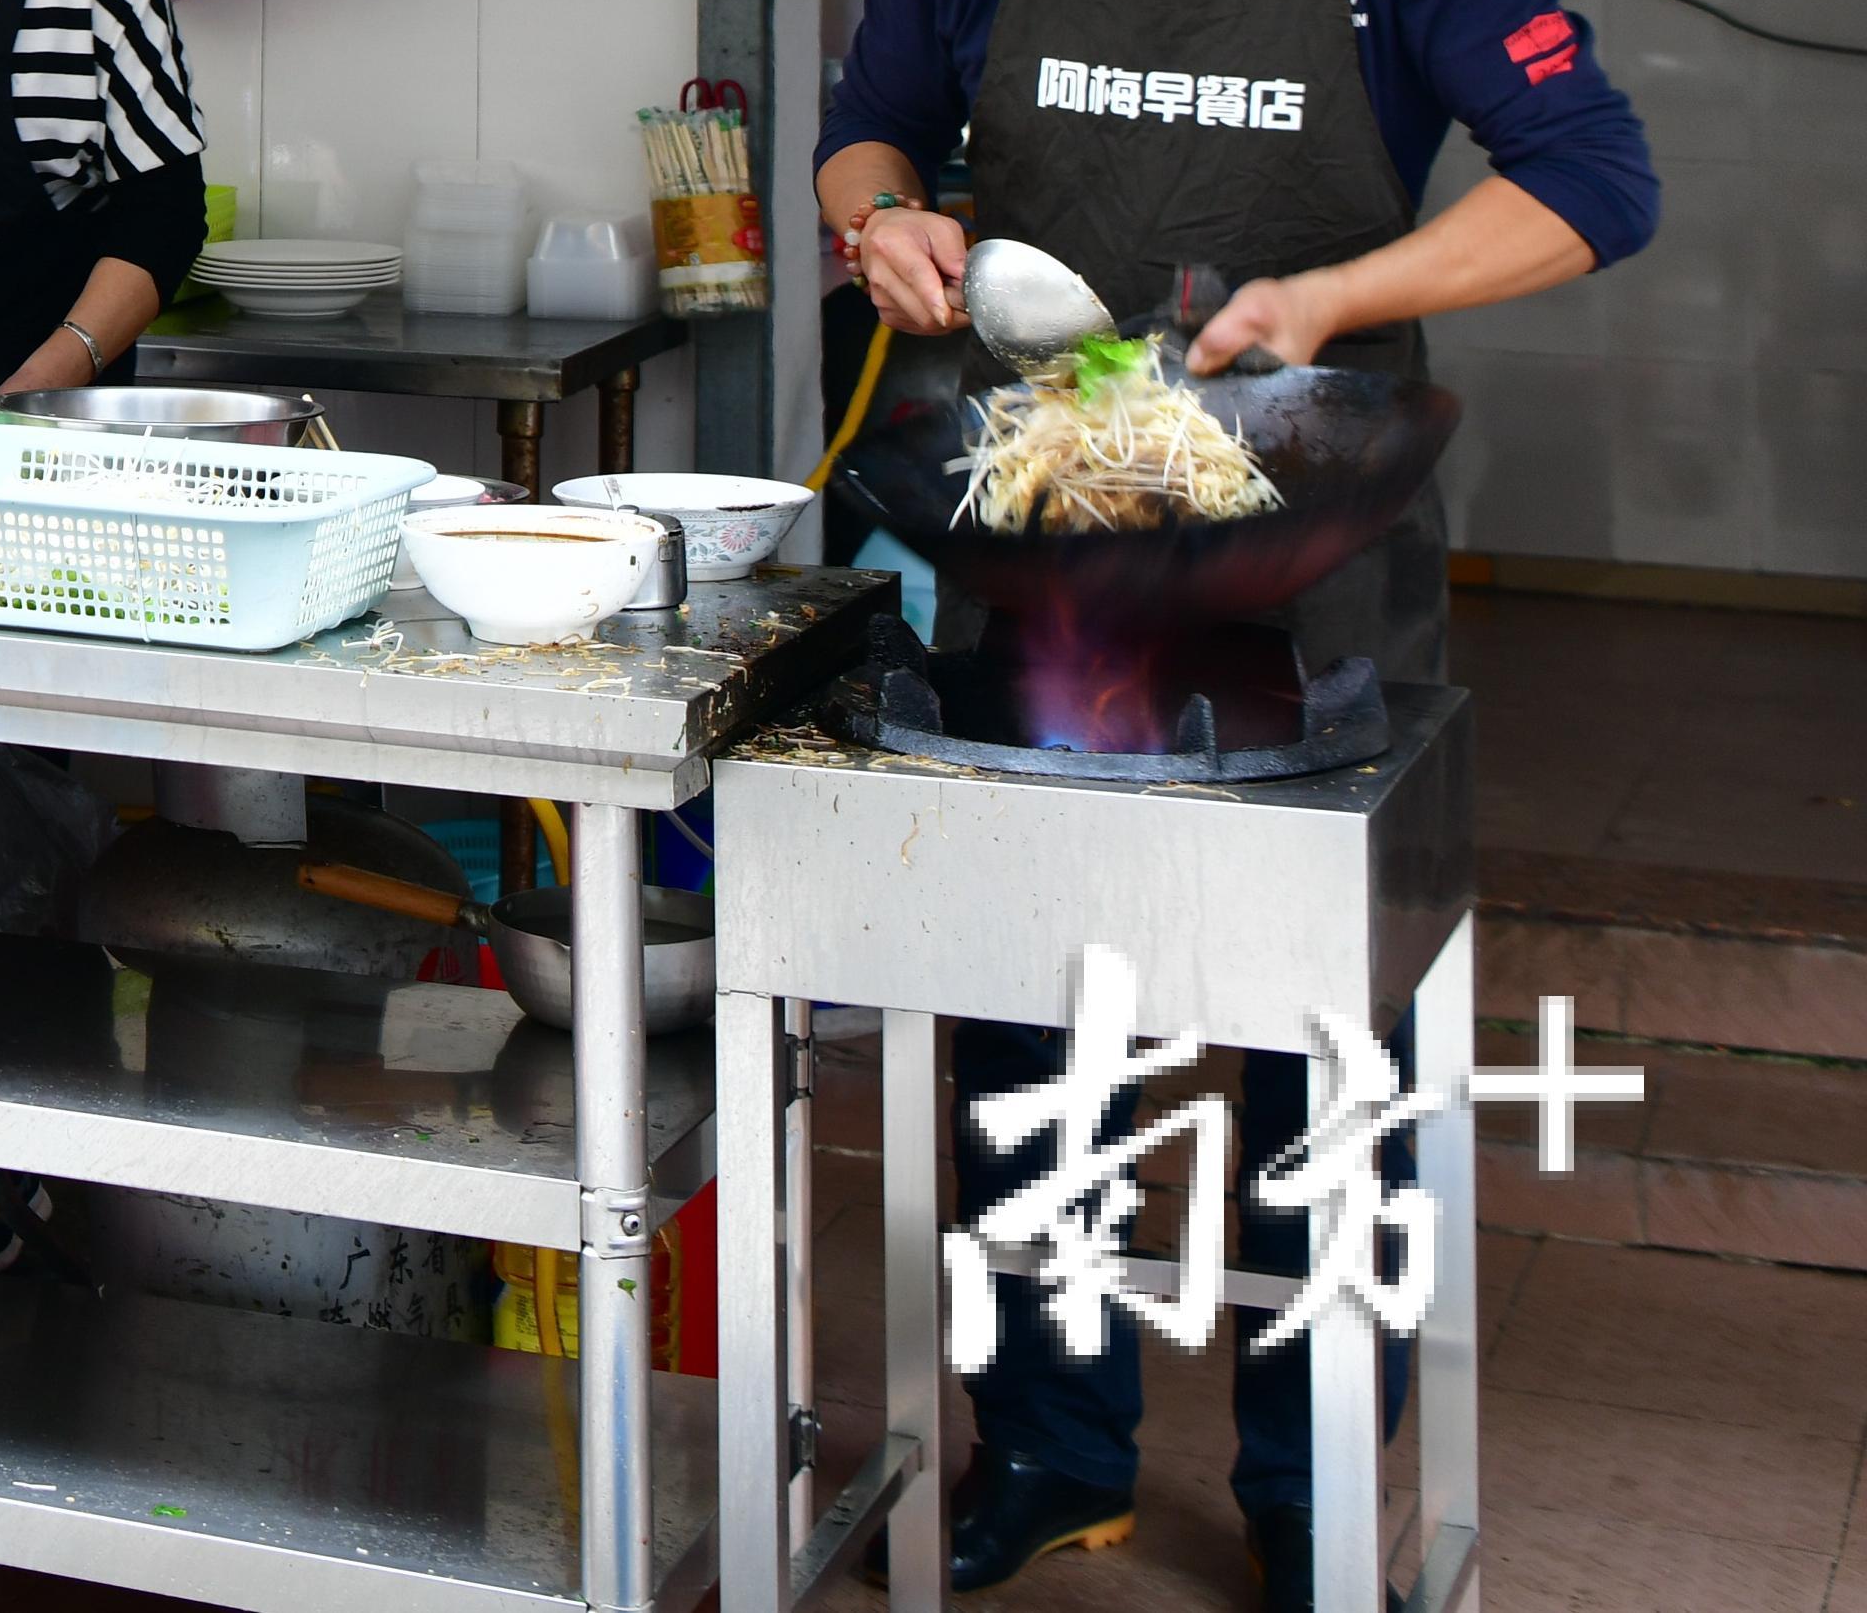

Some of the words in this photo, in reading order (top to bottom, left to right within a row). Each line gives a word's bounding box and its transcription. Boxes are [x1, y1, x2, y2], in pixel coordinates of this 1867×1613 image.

[1037, 57, 1306, 132] 阿梅早餐店
